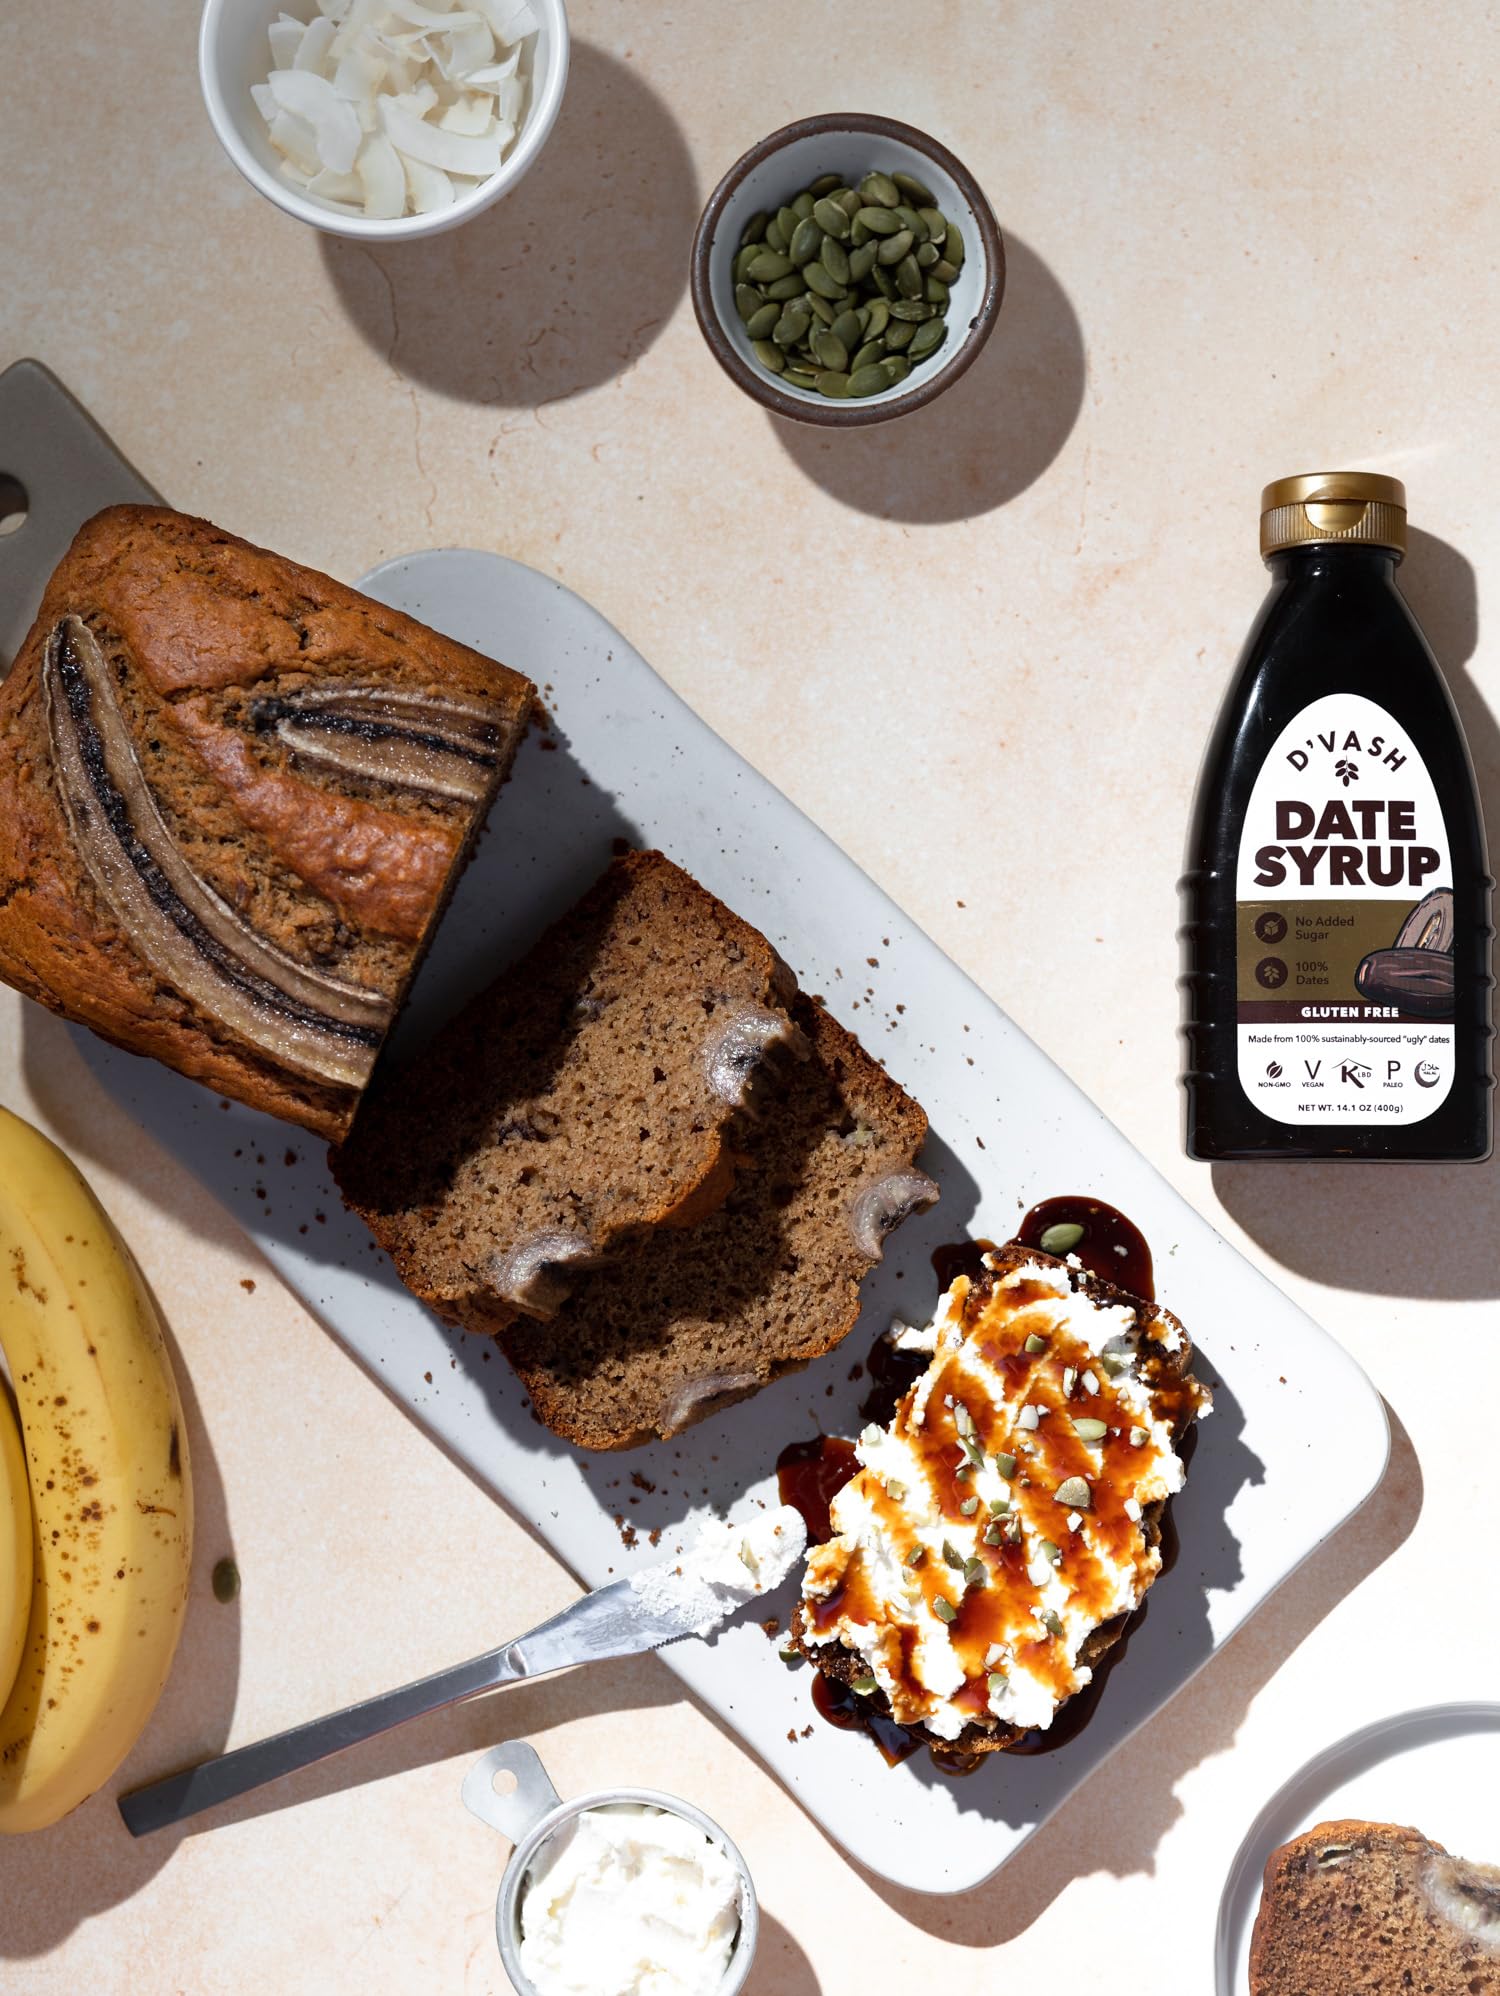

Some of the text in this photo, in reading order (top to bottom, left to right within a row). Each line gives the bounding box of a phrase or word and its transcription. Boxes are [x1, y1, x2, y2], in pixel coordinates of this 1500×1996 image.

[1286, 730, 1408, 772] D'VASH
[1276, 800, 1417, 840] DATE
[1253, 845, 1441, 887] SYRUP
[1295, 916, 1355, 927] No Added
[1295, 929, 1329, 942] Sugar
[1295, 961, 1329, 973] 100%
[1296, 975, 1329, 986] Dates
[1301, 1006, 1400, 1018] GLUTEN FREE
[1248, 1034, 1273, 1043] Made
[1274, 1034, 1294, 1043] from
[1296, 1034, 1320, 1043] 100%
[1321, 1034, 1401, 1045] sustainably-sourced
[1428, 1035, 1450, 1044] dates
[1304, 1060, 1322, 1080] V
[1387, 1060, 1401, 1080] P
[1298, 1104, 1404, 1114] NET WT. 14.1 OZ (400g)
